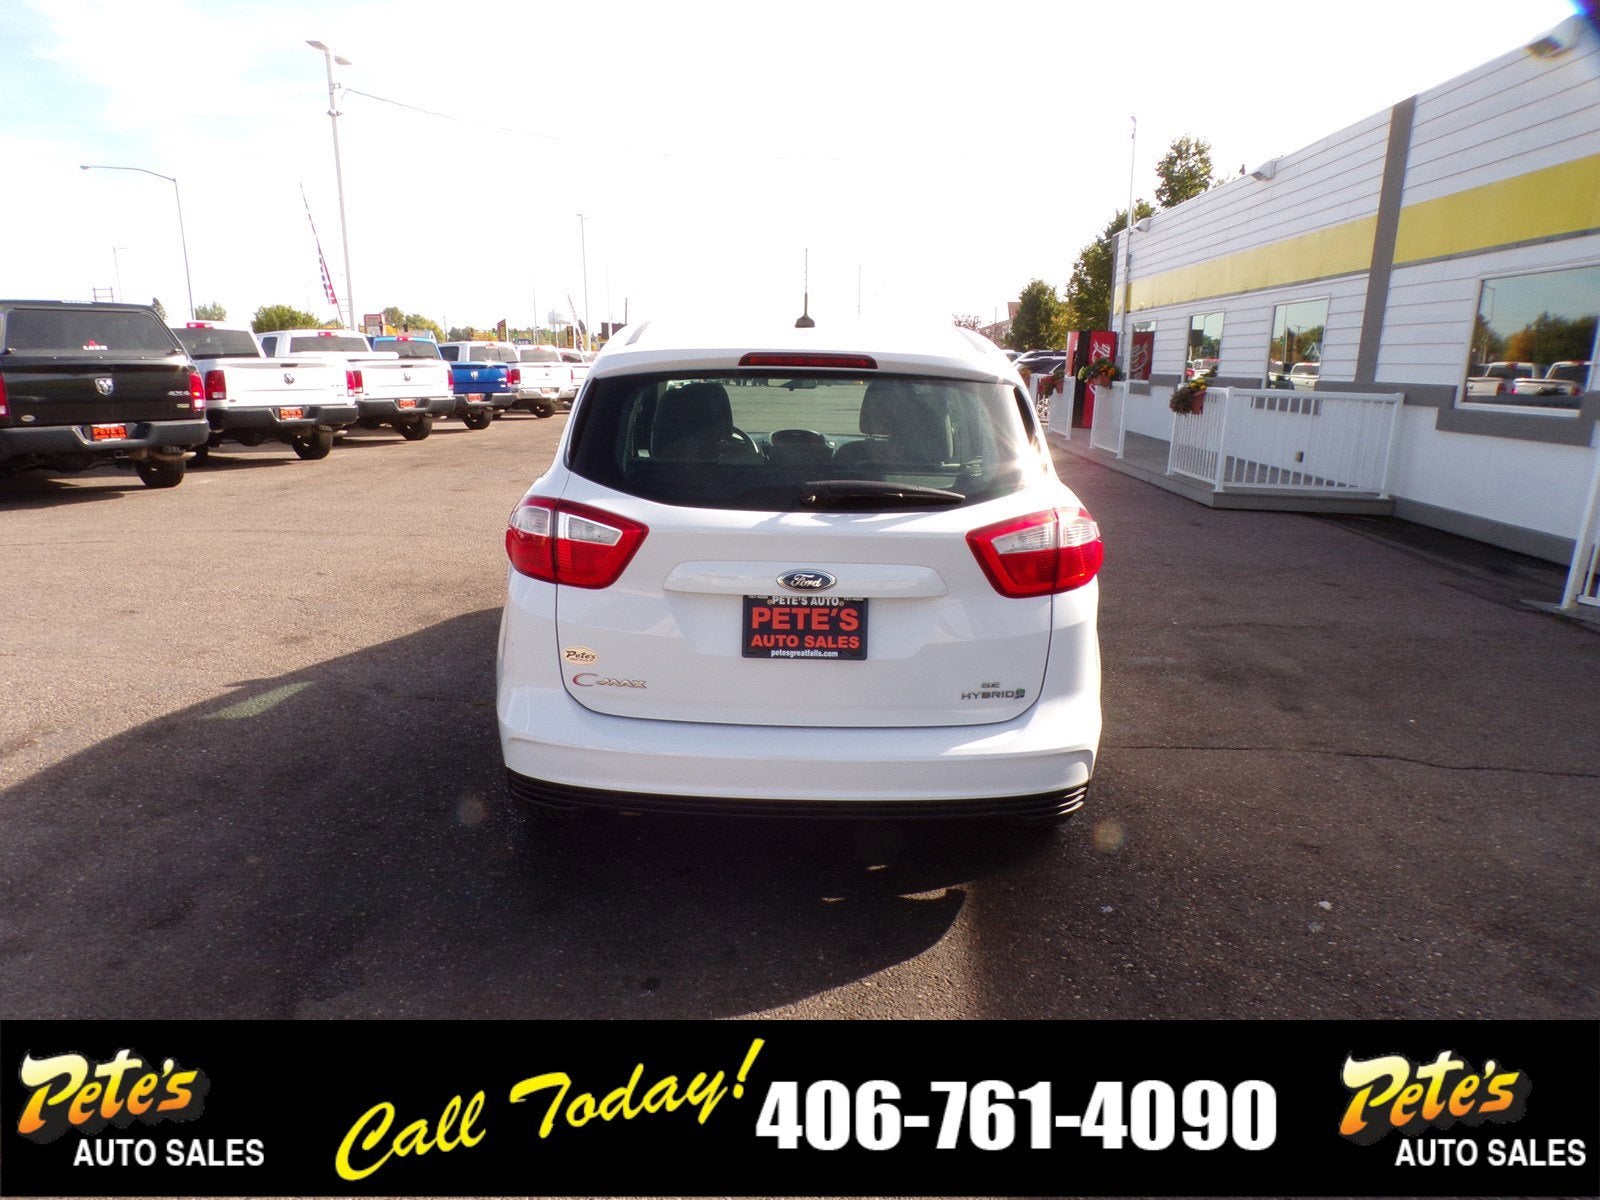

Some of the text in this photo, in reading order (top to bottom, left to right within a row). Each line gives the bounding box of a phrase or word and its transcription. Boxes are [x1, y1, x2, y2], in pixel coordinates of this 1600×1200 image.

[790, 574, 822, 587] Ford
[810, 597, 839, 606] AUTO
[752, 606, 859, 631] PETE'S
[751, 634, 860, 649] AUTO SALES
[771, 649, 839, 658] petesgreatfalls.com
[961, 691, 1015, 700] HYBRID
